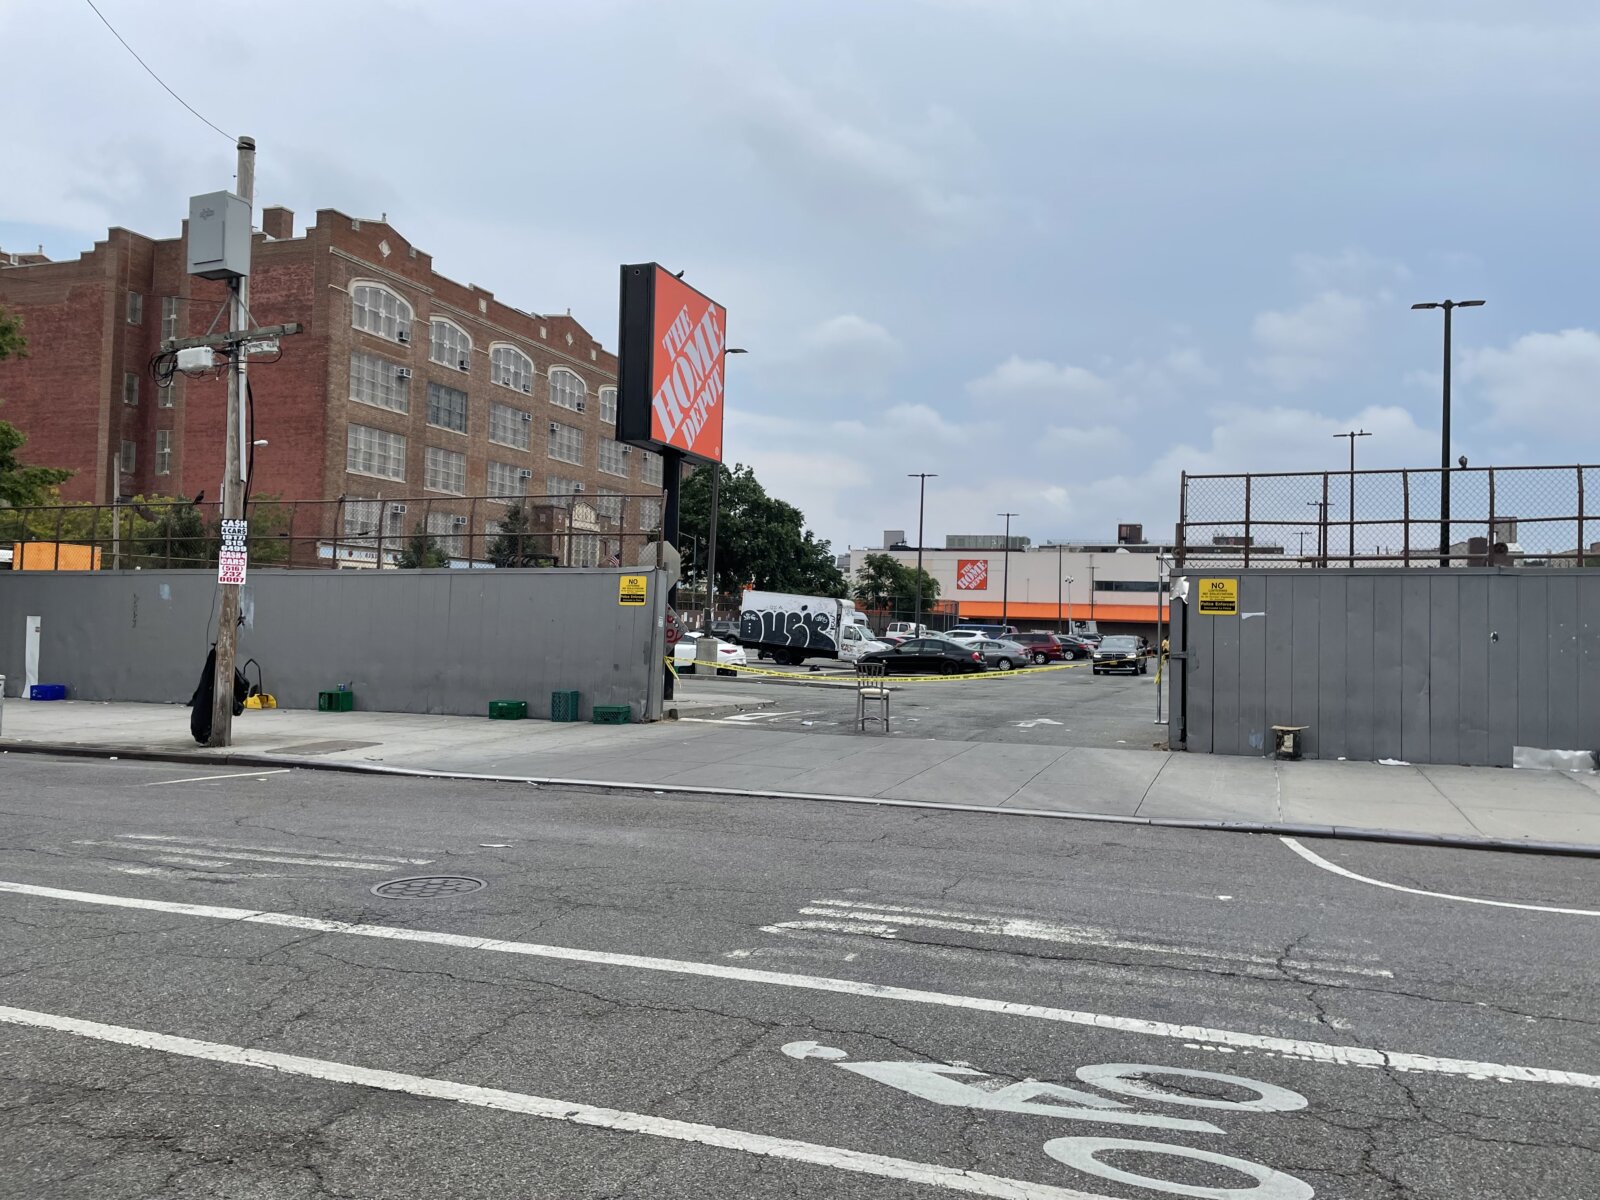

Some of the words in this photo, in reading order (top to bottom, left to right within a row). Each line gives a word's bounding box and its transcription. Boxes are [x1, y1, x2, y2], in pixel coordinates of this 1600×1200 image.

[662, 304, 693, 361] THE
[652, 303, 724, 443] HOME
[681, 364, 723, 450] DEPOT
[957, 560, 987, 589] HOME
[1211, 582, 1225, 590] NO
